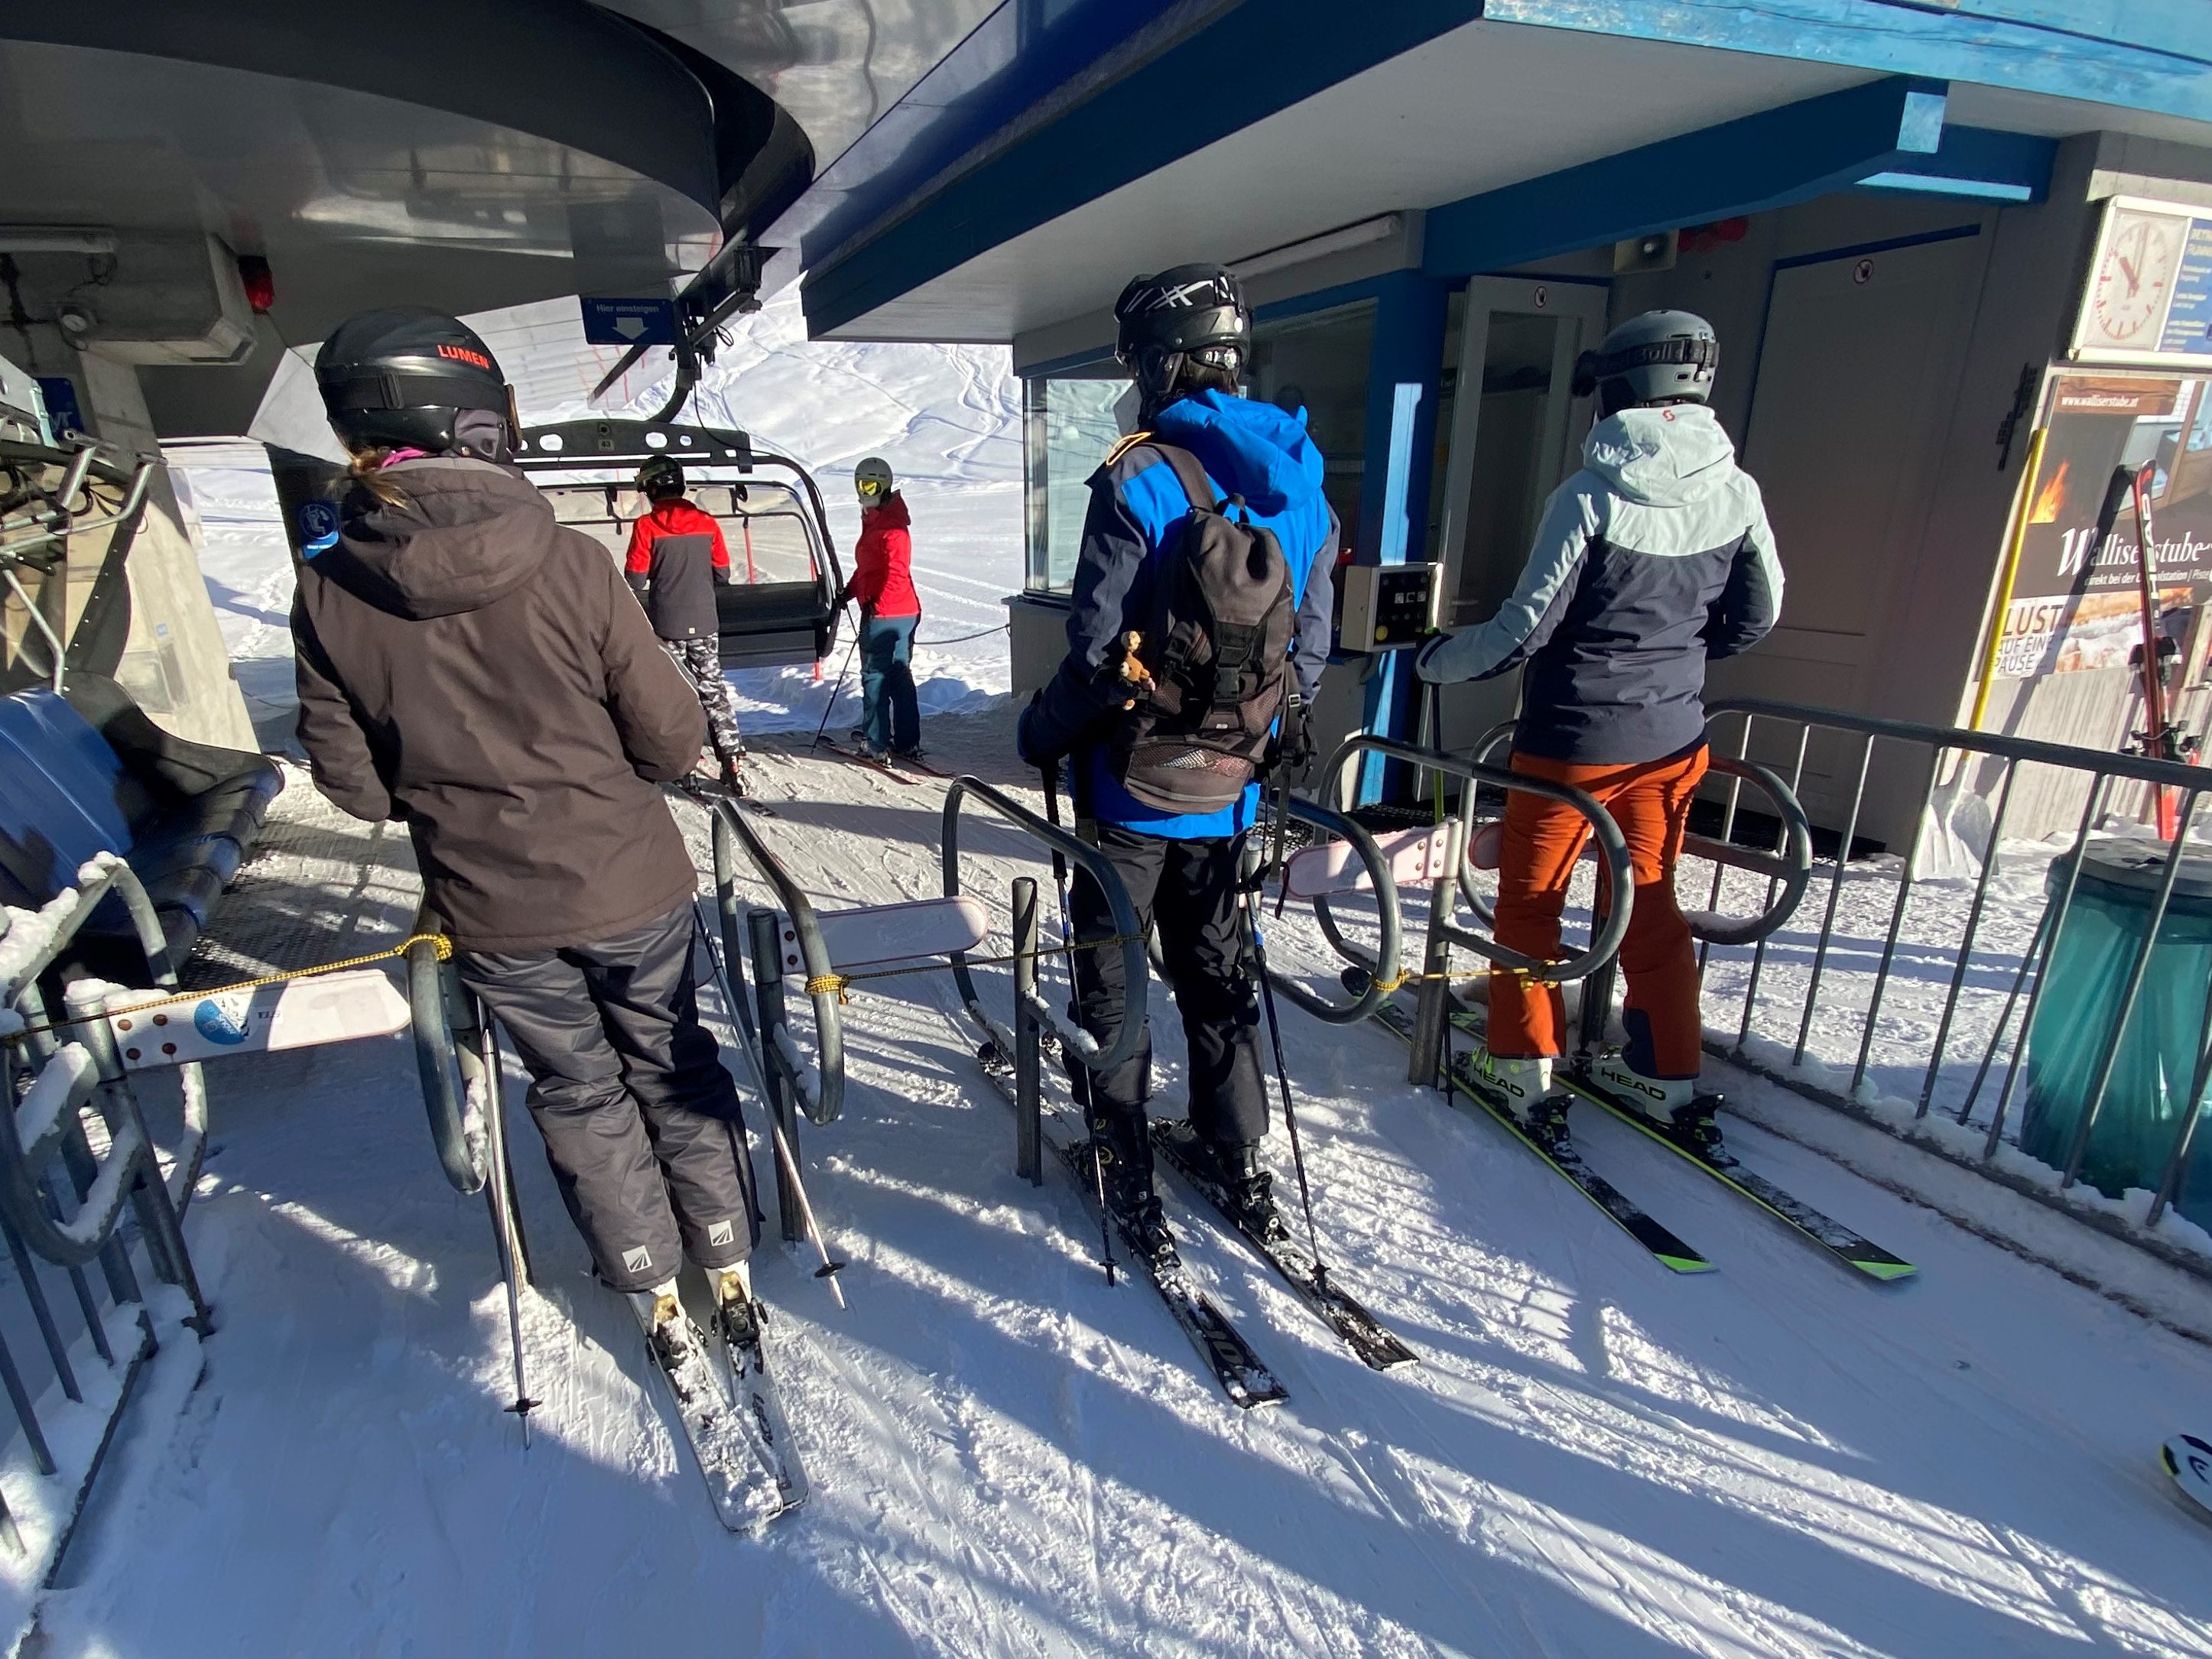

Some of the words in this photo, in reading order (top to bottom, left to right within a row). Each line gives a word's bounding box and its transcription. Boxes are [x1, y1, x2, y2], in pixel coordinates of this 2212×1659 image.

[596, 304, 612, 314] Hier
[616, 304, 659, 314] einsteigen
[437, 345, 489, 369] LUMEN
[2057, 527, 2207, 576] Wallisestube
[2002, 605, 2064, 636] LUST
[1601, 1066, 1667, 1101] HEAD
